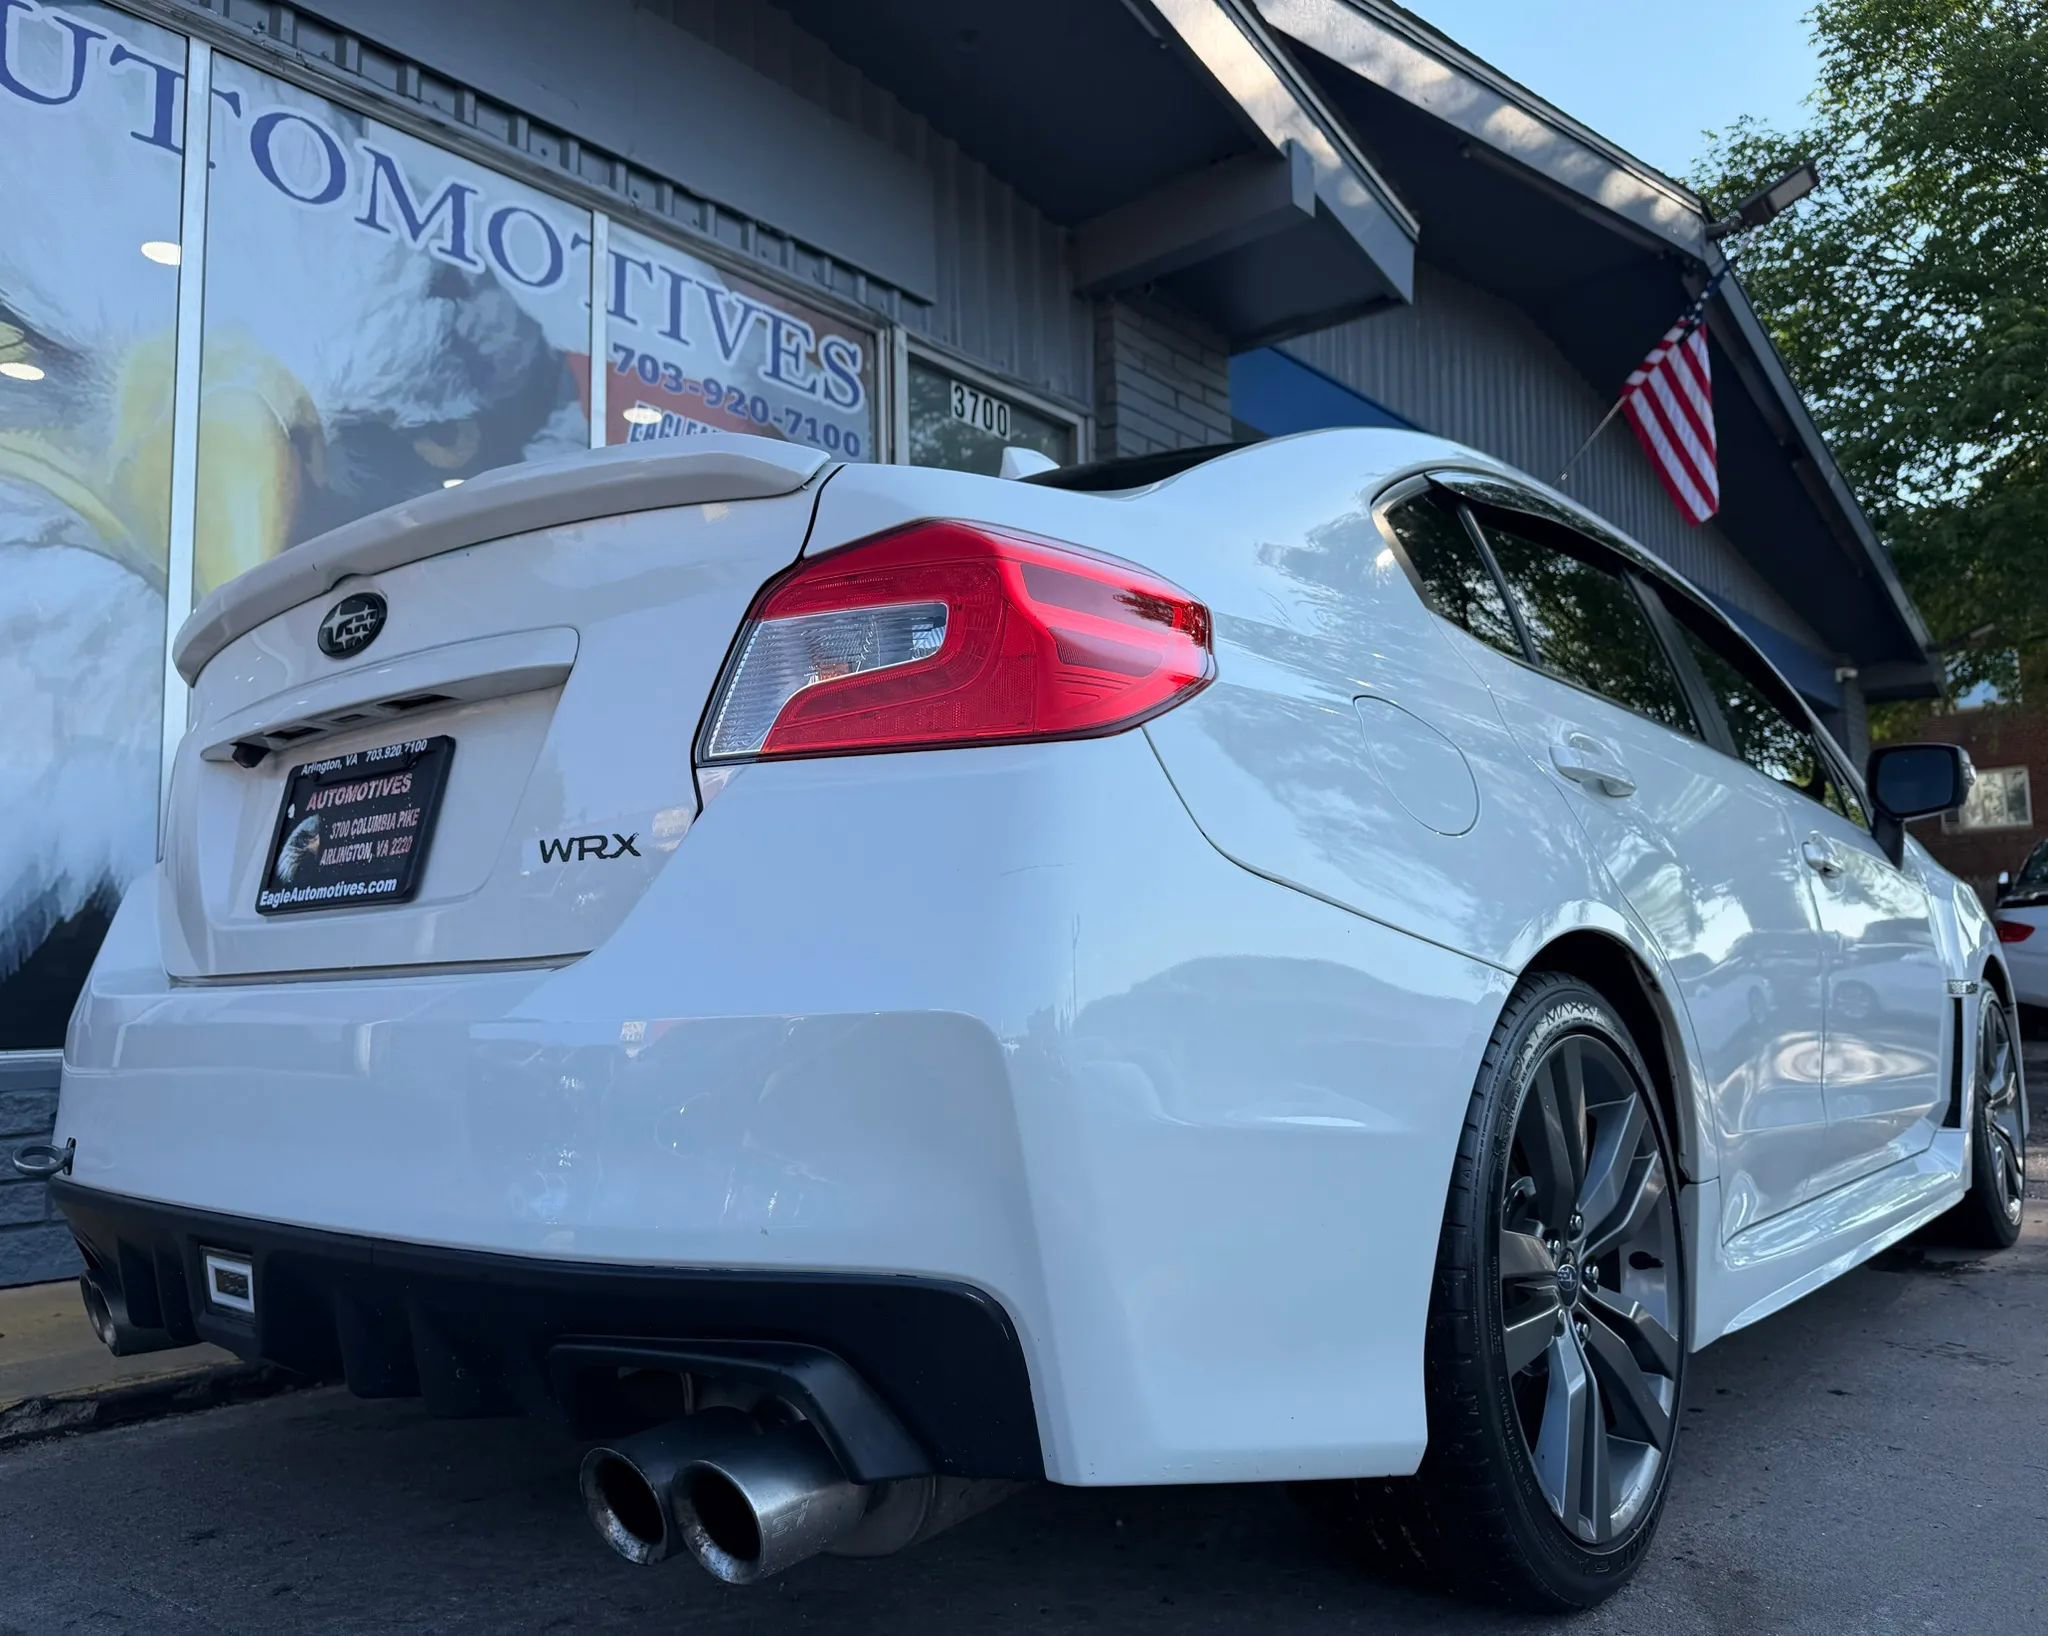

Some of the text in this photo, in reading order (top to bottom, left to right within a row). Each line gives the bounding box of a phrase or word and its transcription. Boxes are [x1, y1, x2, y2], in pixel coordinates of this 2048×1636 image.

[612, 343, 862, 458] 703-920-7100
[952, 384, 1008, 437] 3700
[346, 753, 358, 767] VA
[306, 773, 413, 812] AUTOMOTIVES
[329, 808, 420, 840] 3700 COLUMBIA PIKE
[320, 841, 373, 866] ARLINGTON,
[376, 839, 389, 858] VA
[539, 832, 642, 864] WRX
[259, 878, 397, 908] EagleAutomotives.com
